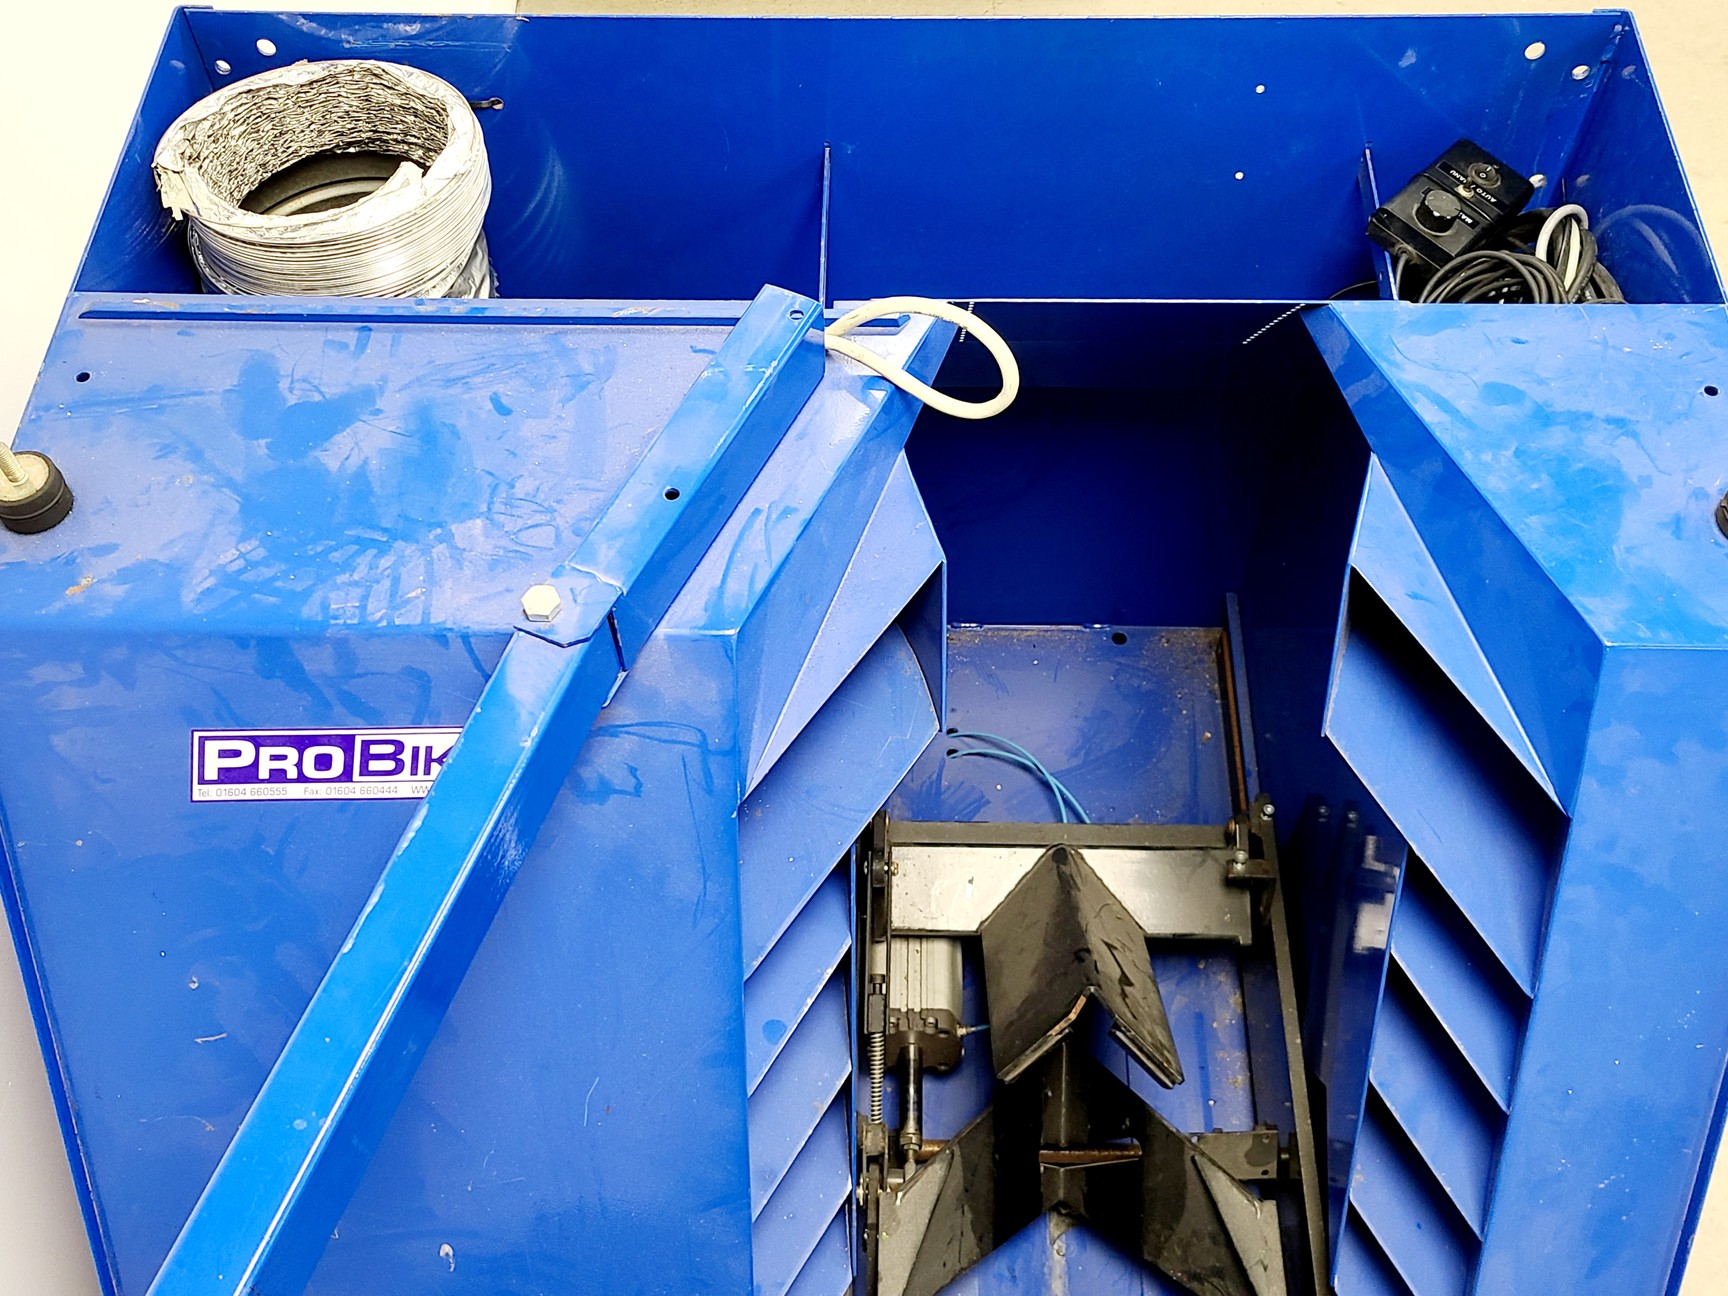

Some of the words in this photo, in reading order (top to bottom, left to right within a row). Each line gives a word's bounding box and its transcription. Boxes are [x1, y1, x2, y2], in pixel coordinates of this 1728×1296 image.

[1476, 188, 1497, 202] AUTO
[197, 788, 212, 798] Tel:
[215, 787, 247, 797] 01604
[250, 786, 288, 796] 660555
[325, 785, 356, 795] 01604
[359, 784, 398, 795] 660444
